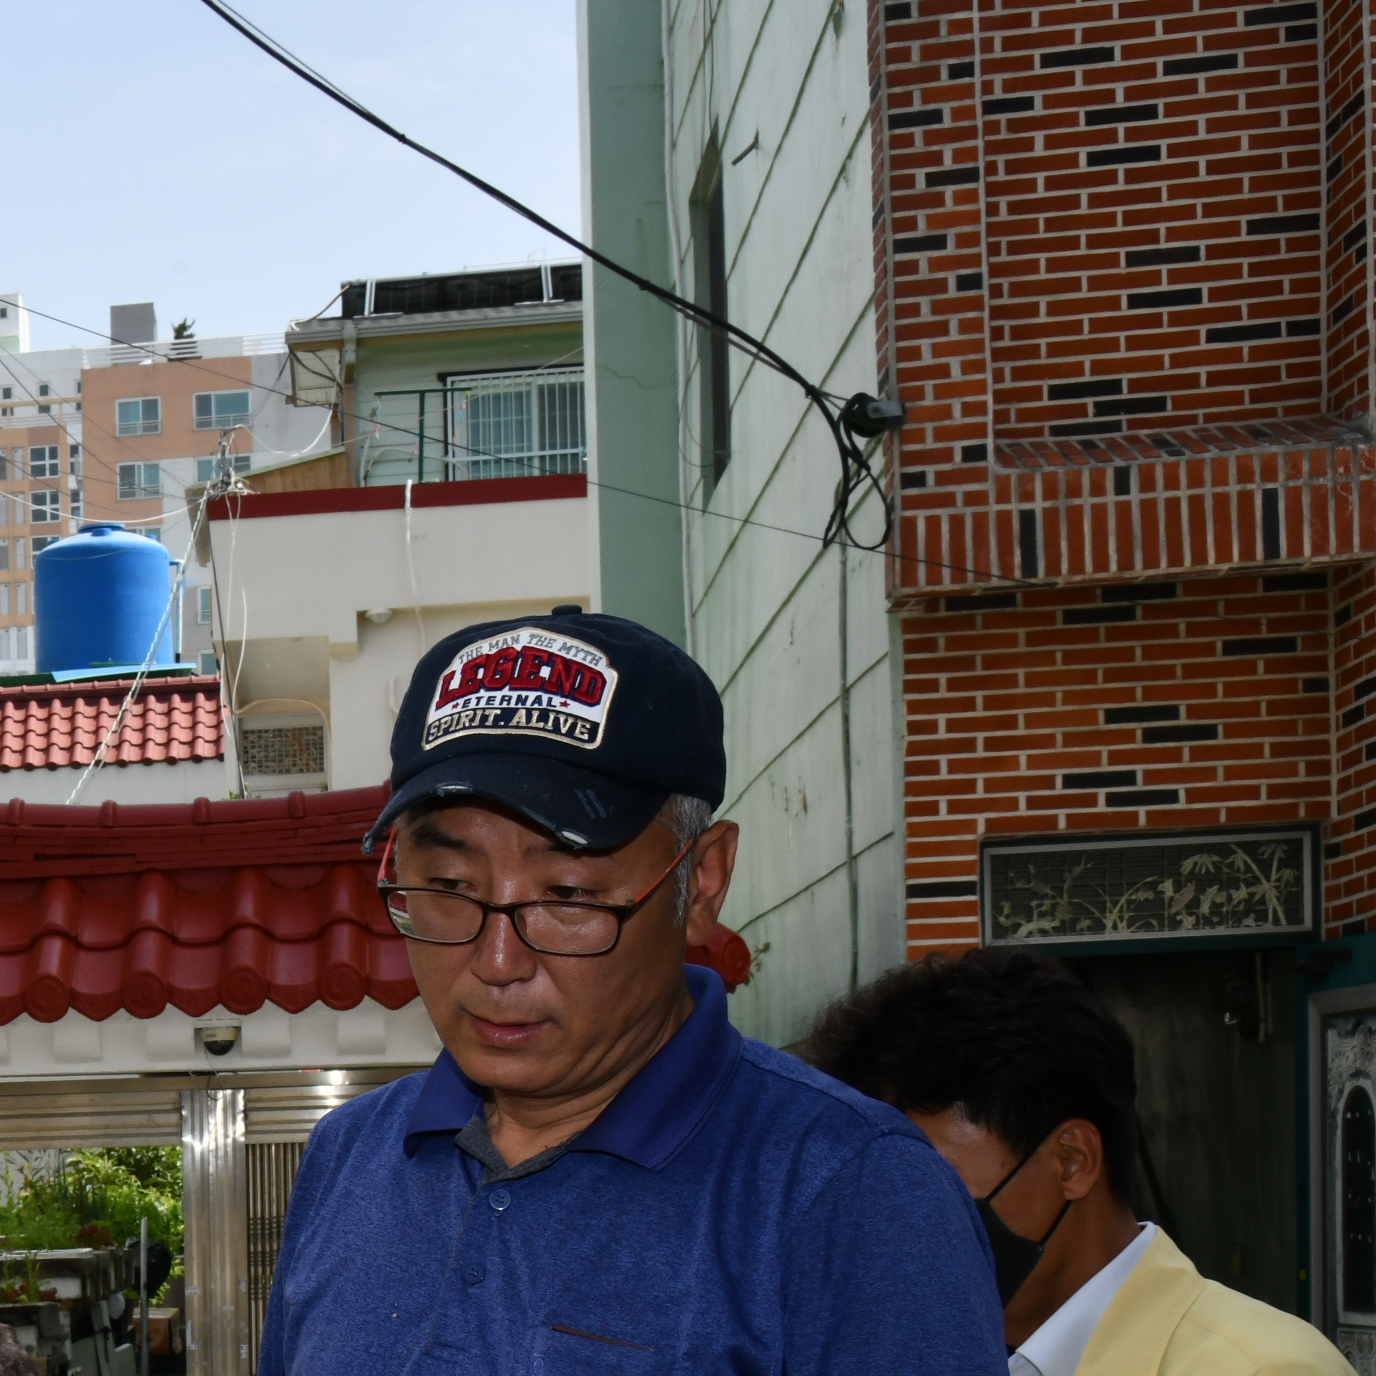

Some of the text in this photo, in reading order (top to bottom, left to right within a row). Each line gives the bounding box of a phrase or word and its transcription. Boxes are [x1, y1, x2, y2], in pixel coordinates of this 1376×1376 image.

[457, 633, 603, 667] THE MAN THE MYTH
[435, 645, 608, 711] LEGEND
[460, 694, 558, 709] ETERNAL
